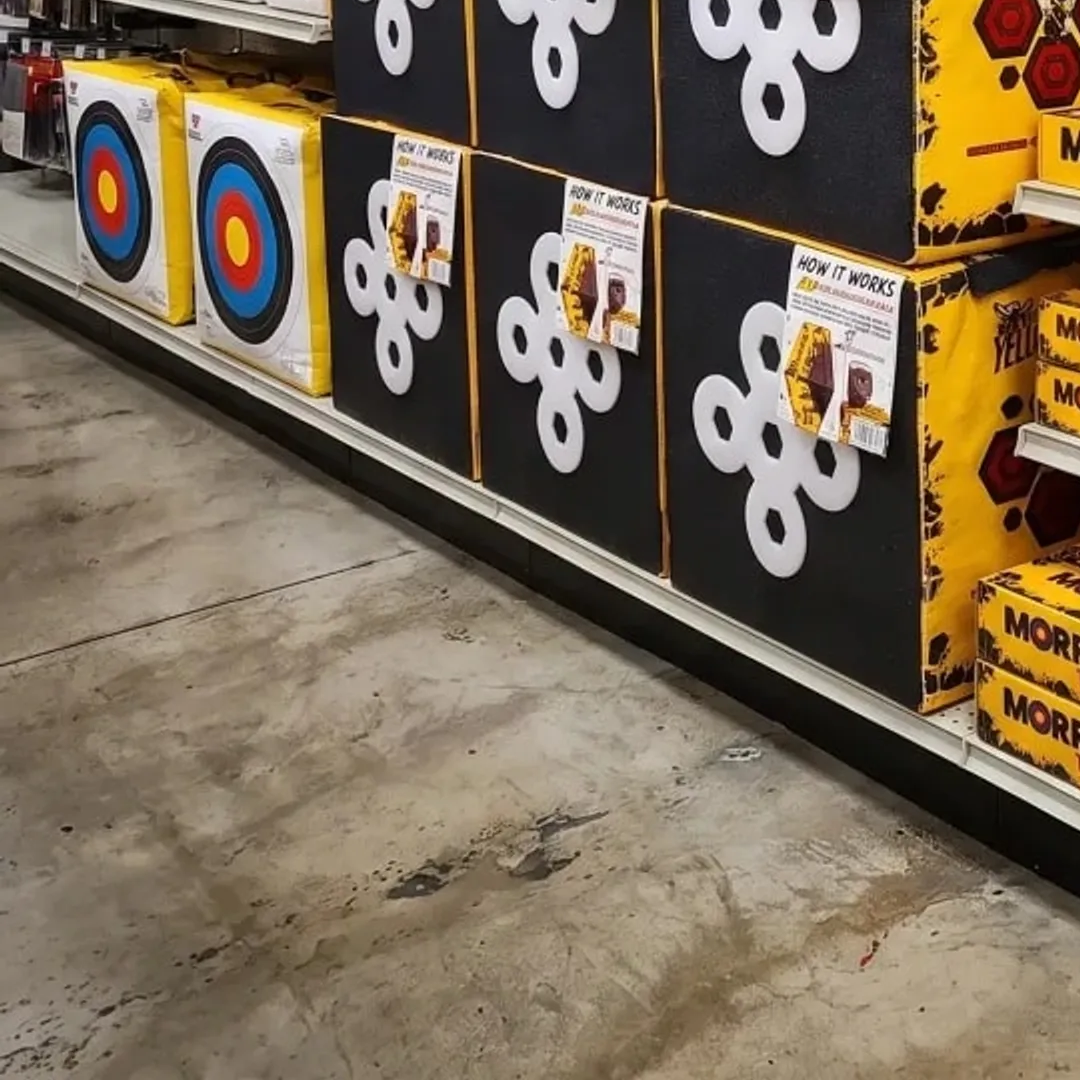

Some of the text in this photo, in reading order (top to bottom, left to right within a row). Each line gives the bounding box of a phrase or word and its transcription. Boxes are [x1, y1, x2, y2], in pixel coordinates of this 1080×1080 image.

[569, 184, 593, 201] HOW
[606, 192, 642, 215] WORKS
[797, 254, 896, 298] HOW IT WORKS
